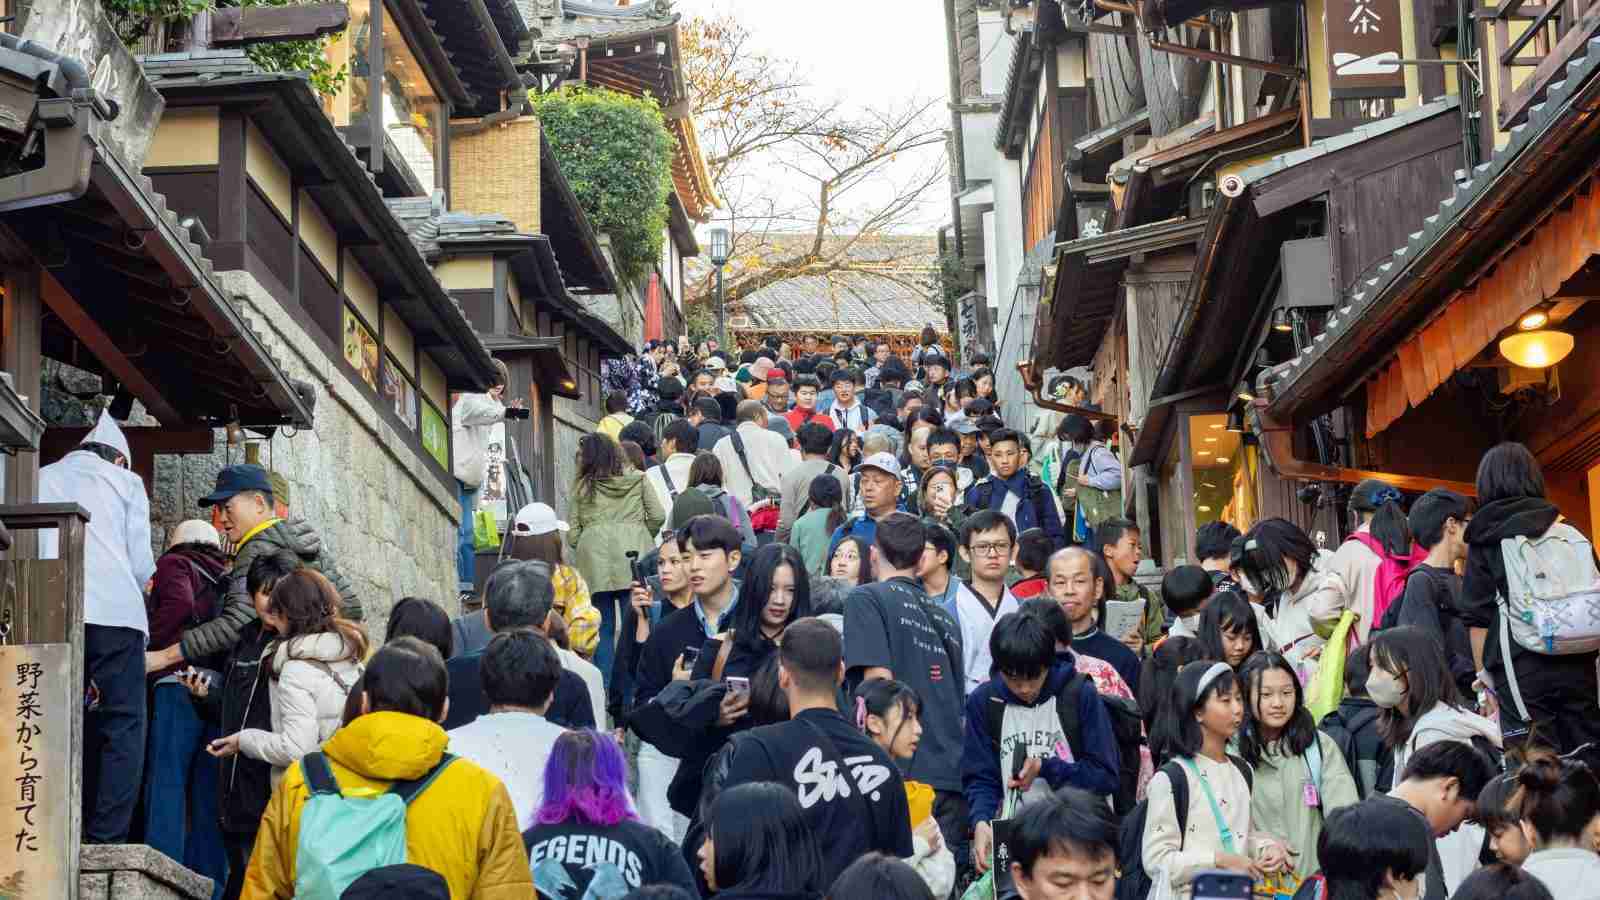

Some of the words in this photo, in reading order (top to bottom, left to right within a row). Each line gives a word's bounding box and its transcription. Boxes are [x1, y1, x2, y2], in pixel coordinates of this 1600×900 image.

[15, 662, 44, 852] 野菜から育てた
